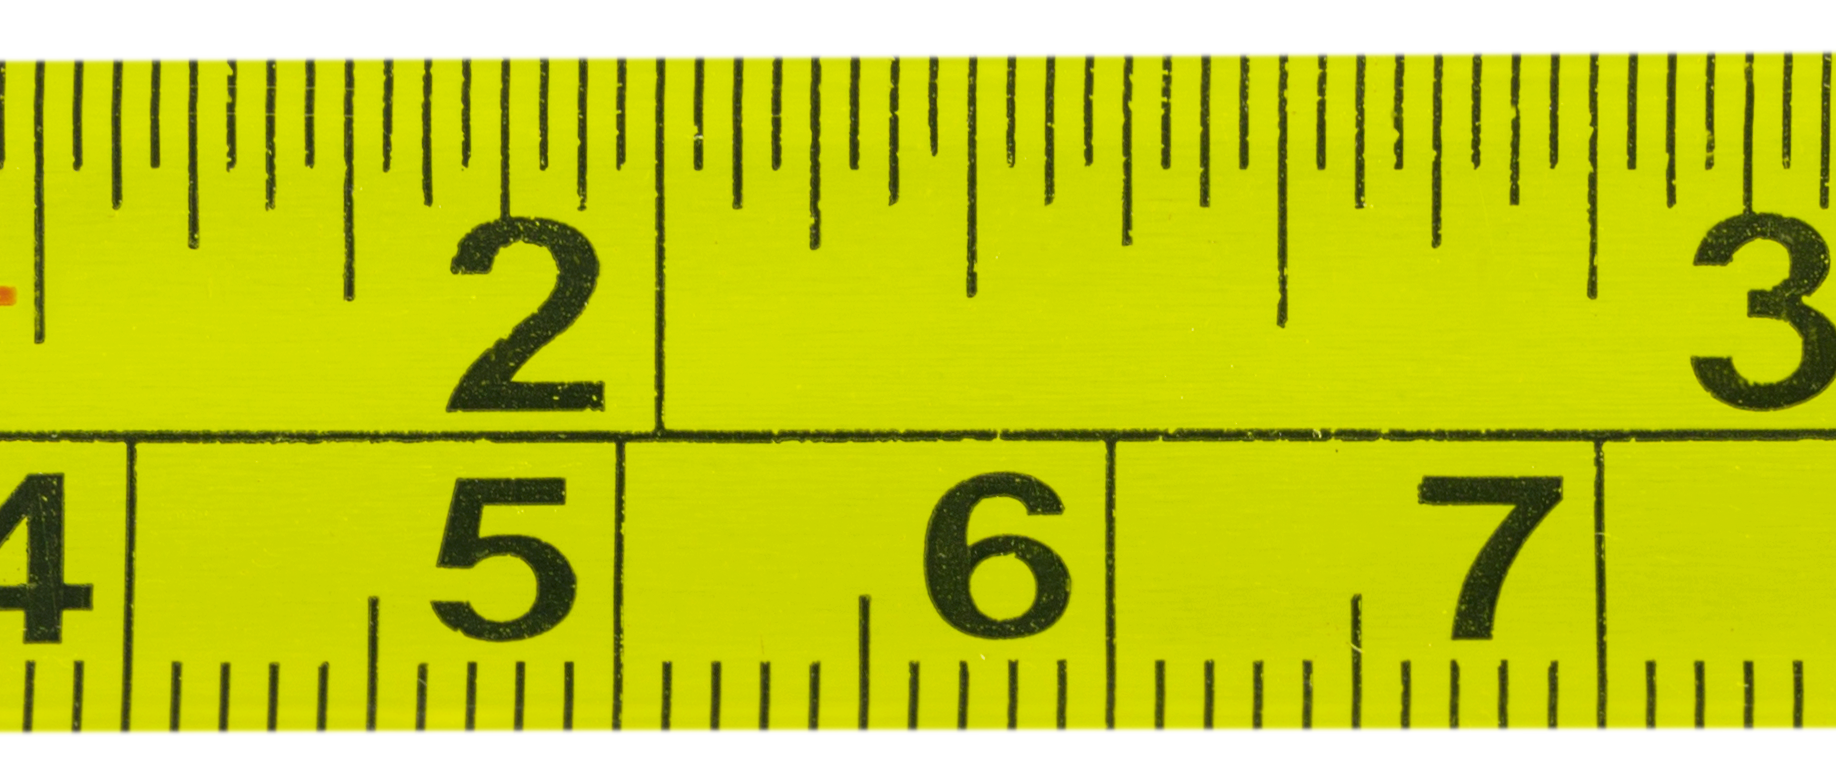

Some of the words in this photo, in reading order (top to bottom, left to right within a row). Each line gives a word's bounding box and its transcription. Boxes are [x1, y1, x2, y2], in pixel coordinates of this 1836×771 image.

[446, 217, 604, 412] 2
[430, 477, 577, 642] 5
[923, 471, 1072, 640] 6
[1418, 476, 1564, 641] 7
